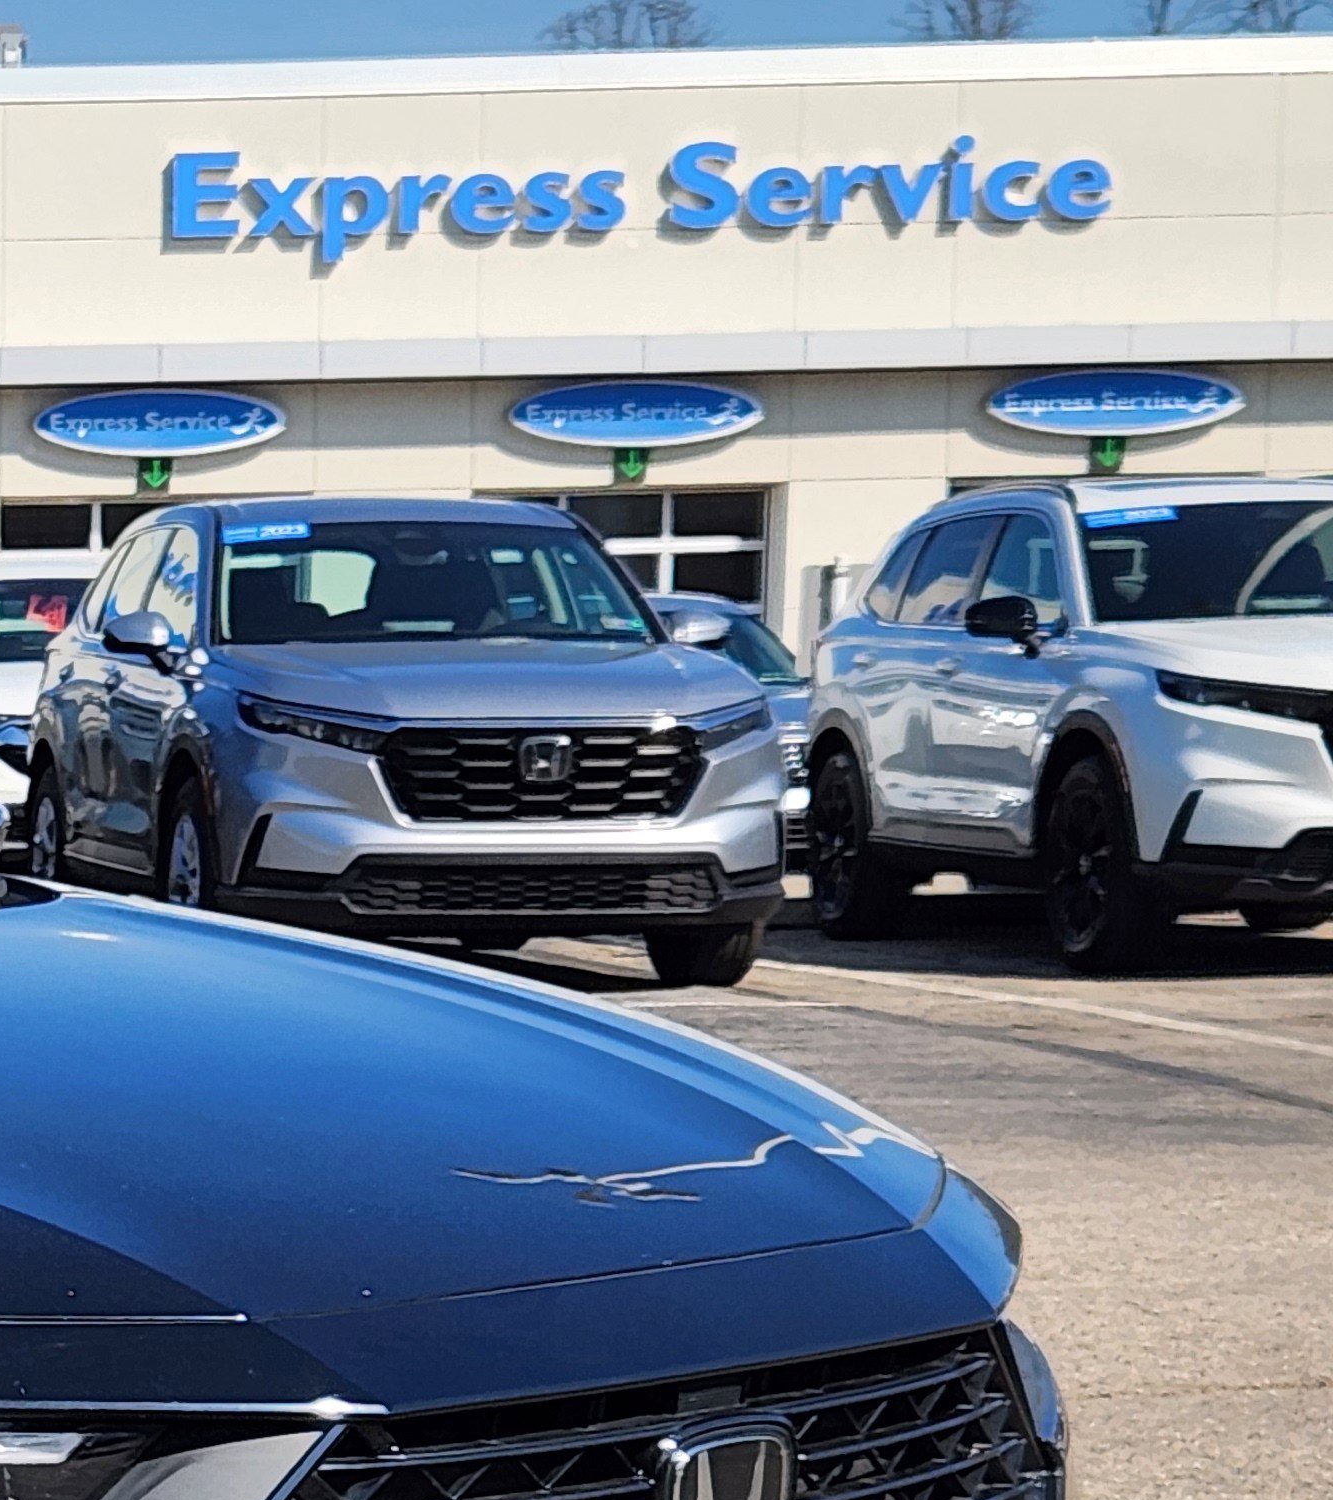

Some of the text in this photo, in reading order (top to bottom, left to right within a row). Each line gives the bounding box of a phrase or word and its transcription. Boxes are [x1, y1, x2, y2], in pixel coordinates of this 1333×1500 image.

[171, 134, 1112, 262] Express Service
[50, 412, 231, 438] Express Service
[525, 402, 707, 428] Express Service
